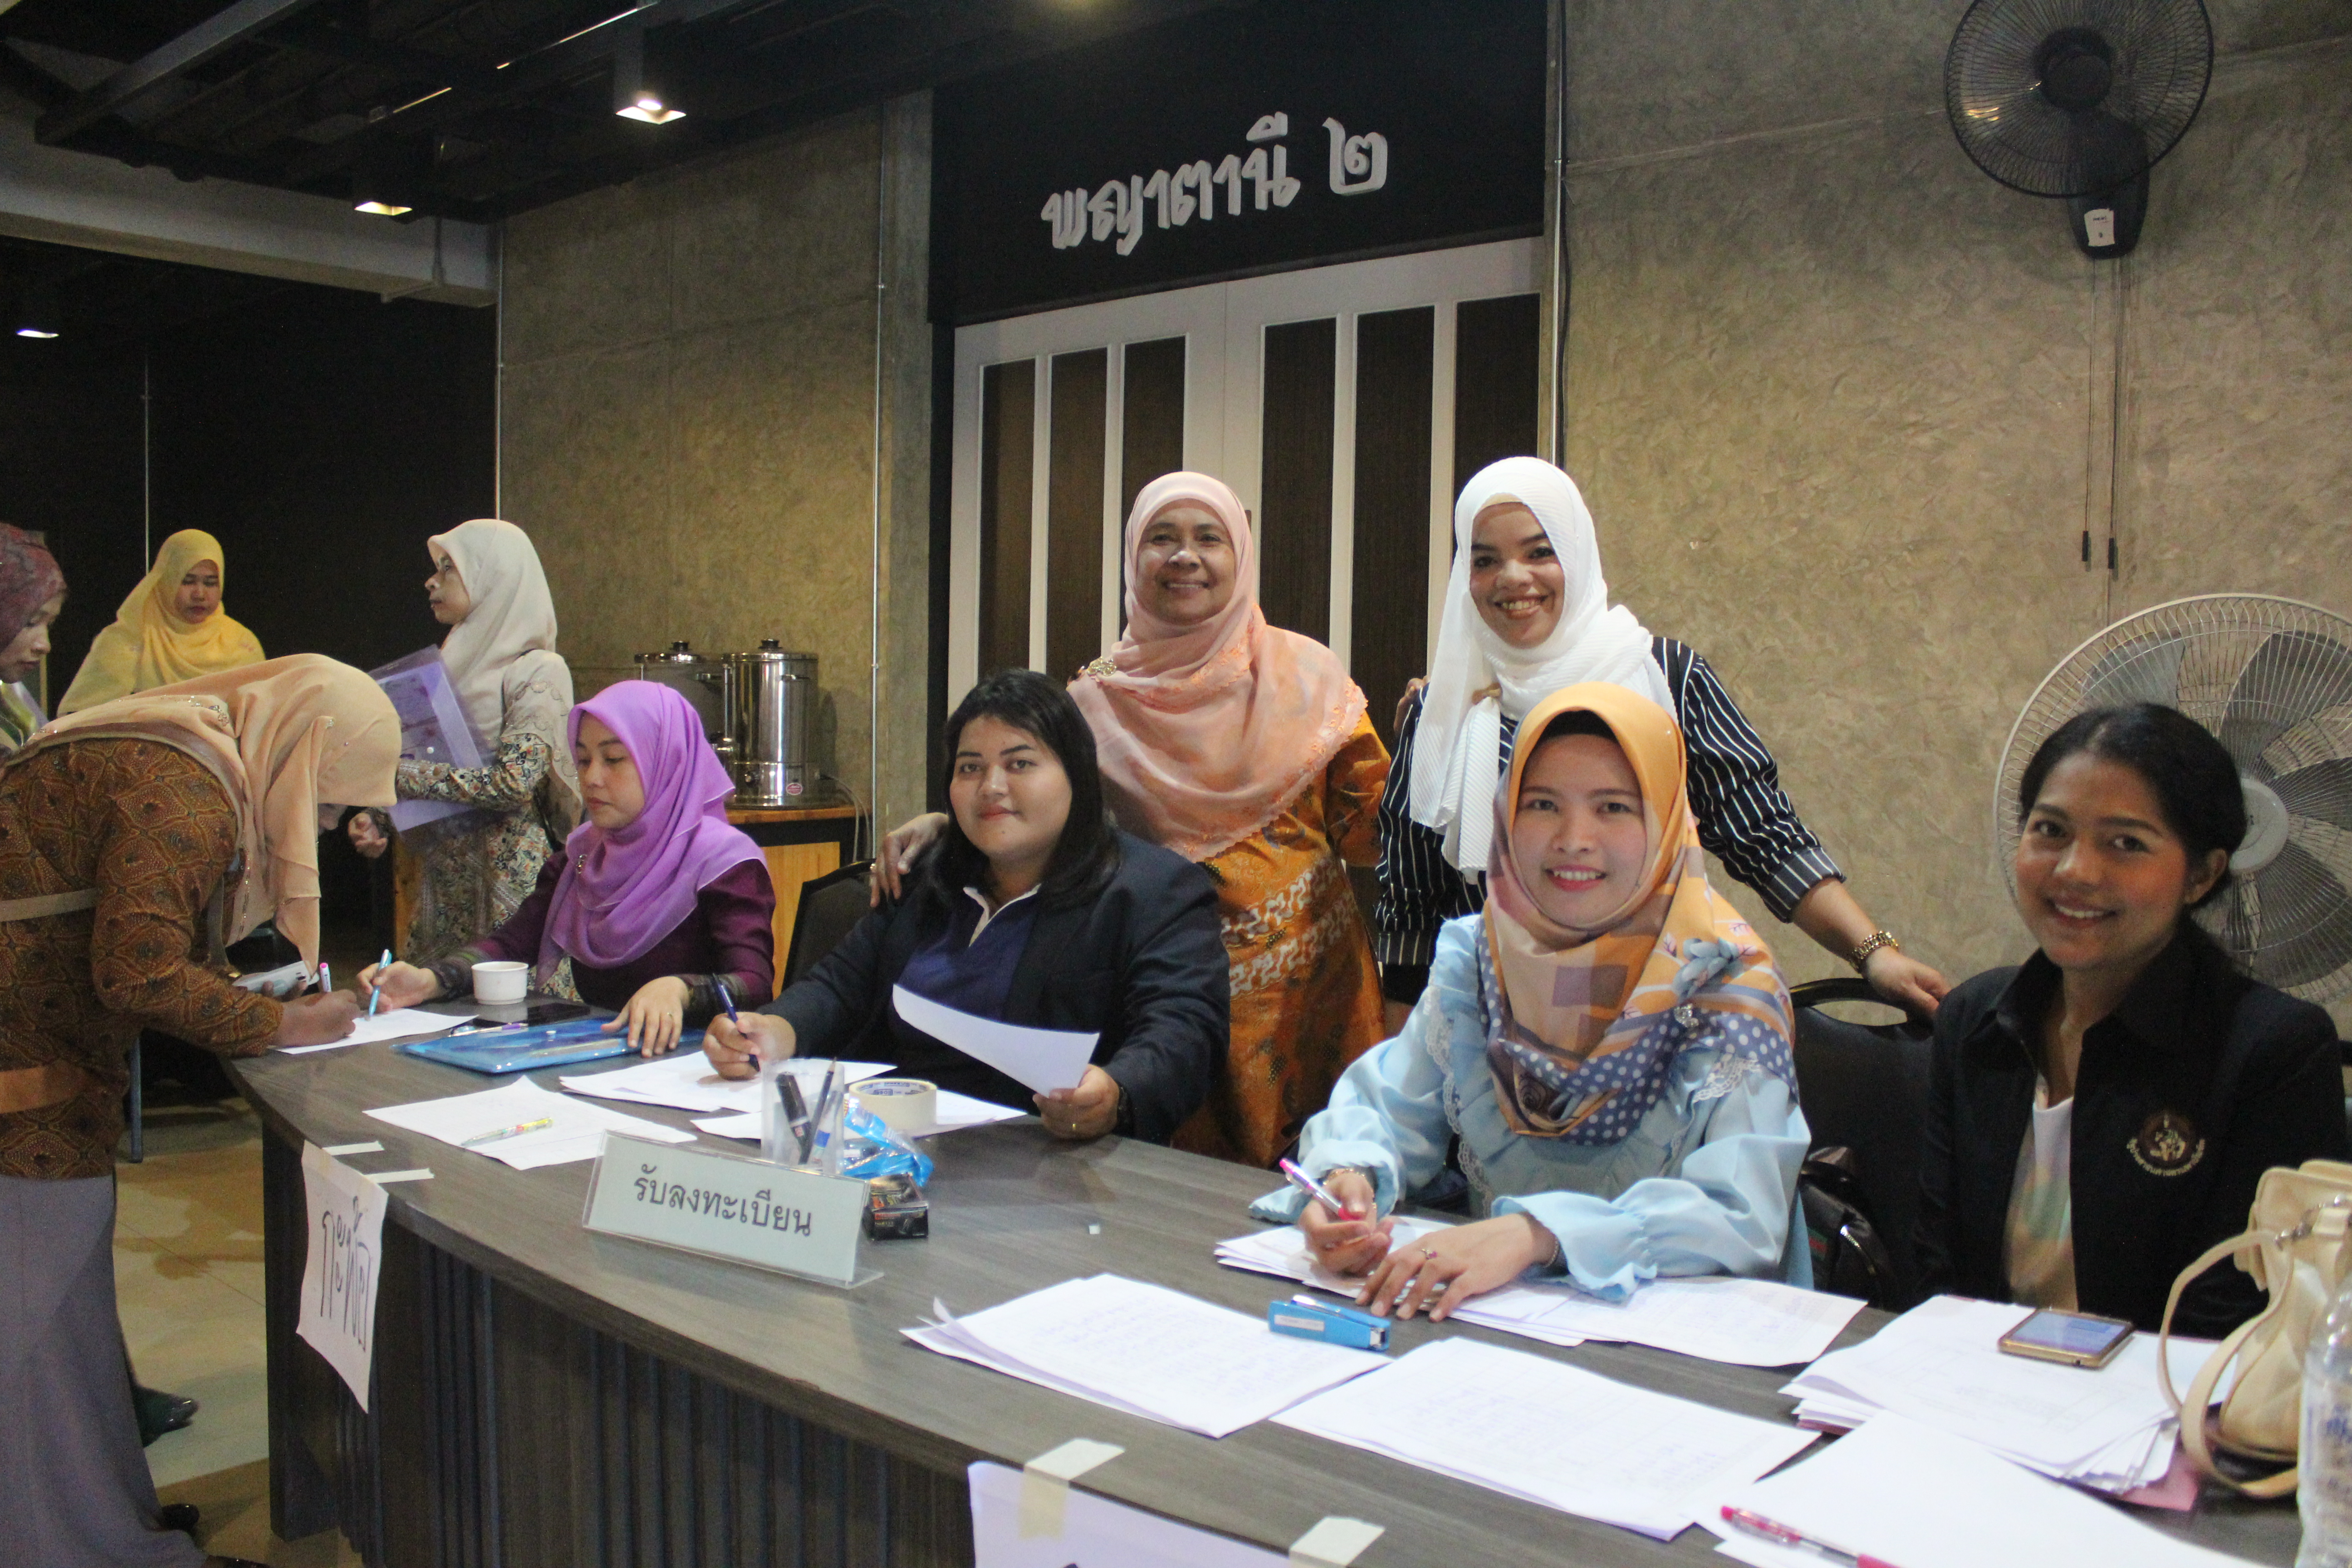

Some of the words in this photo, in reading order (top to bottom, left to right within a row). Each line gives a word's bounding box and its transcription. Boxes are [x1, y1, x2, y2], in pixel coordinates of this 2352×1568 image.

[1041, 112, 1301, 256] พญาตานี
[1323, 117, 1388, 196] ๒
[634, 1163, 811, 1237] รับลงทะเบียน
